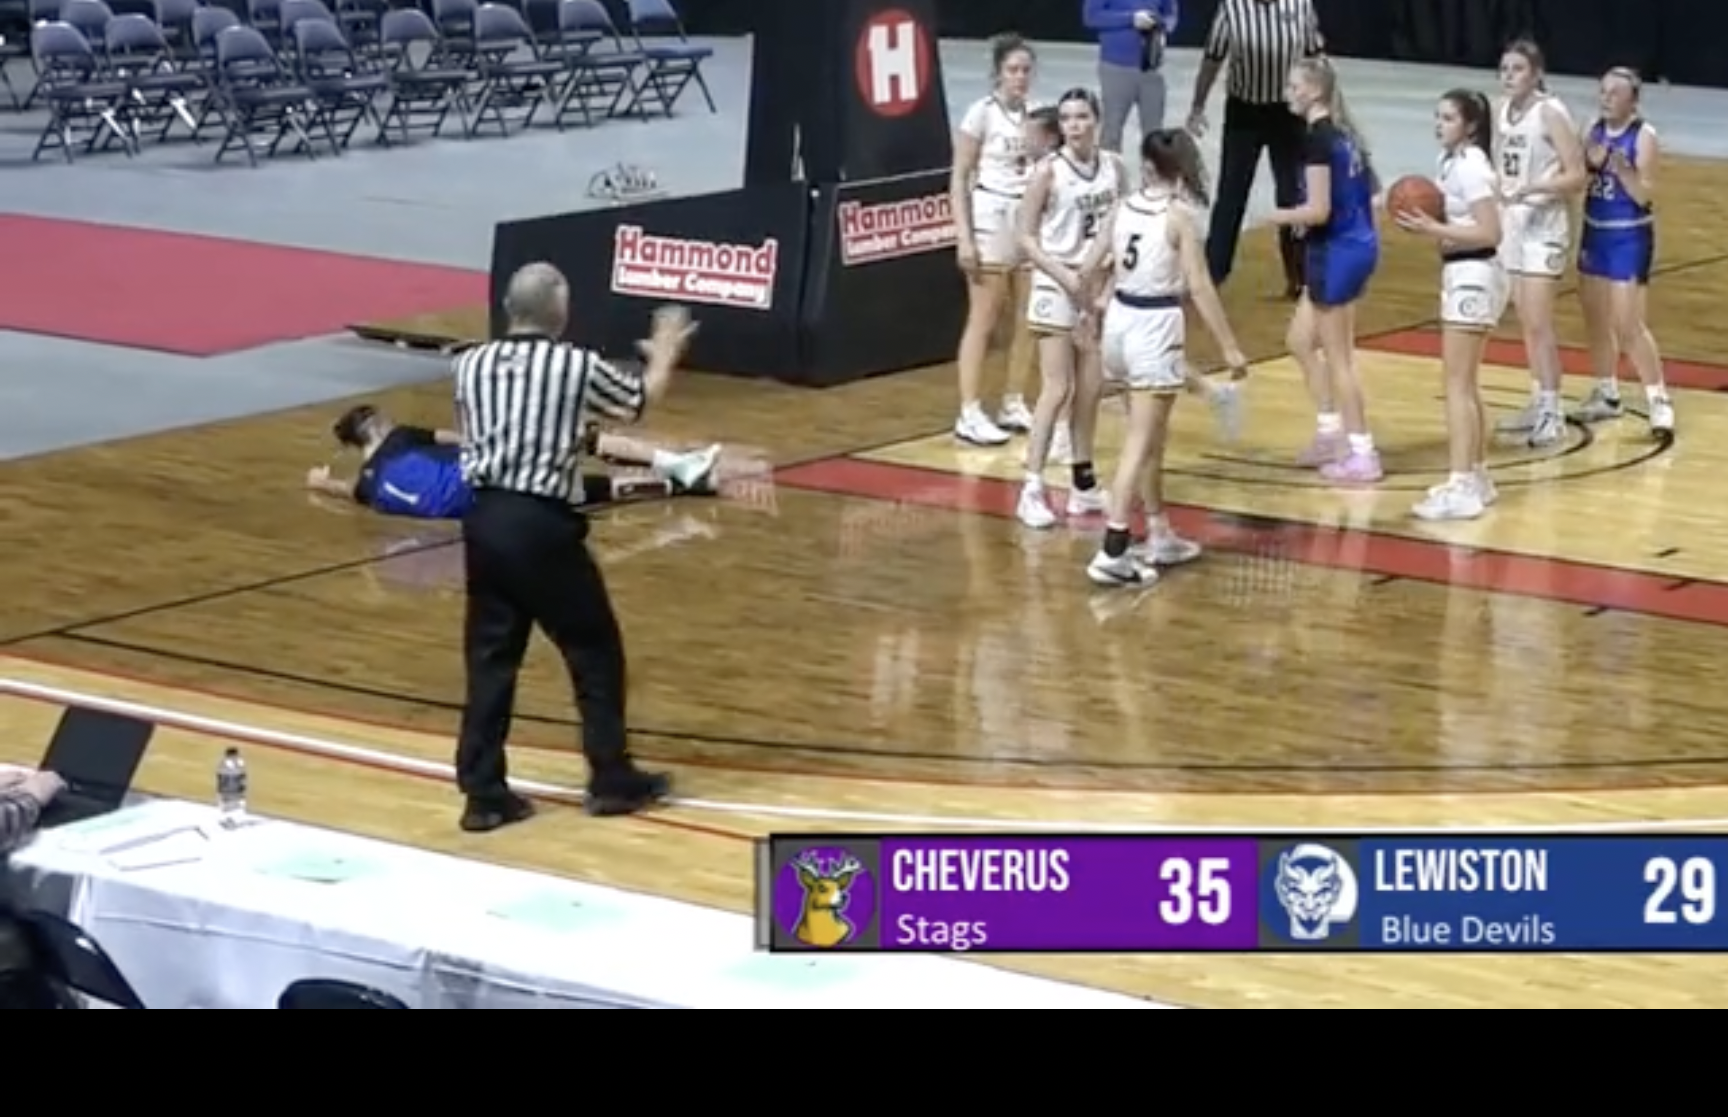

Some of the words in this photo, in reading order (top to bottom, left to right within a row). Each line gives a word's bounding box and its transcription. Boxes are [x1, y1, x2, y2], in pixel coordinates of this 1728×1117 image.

[844, 195, 955, 233] Hammon
[619, 229, 774, 275] Hammond
[1122, 233, 1142, 272] 5
